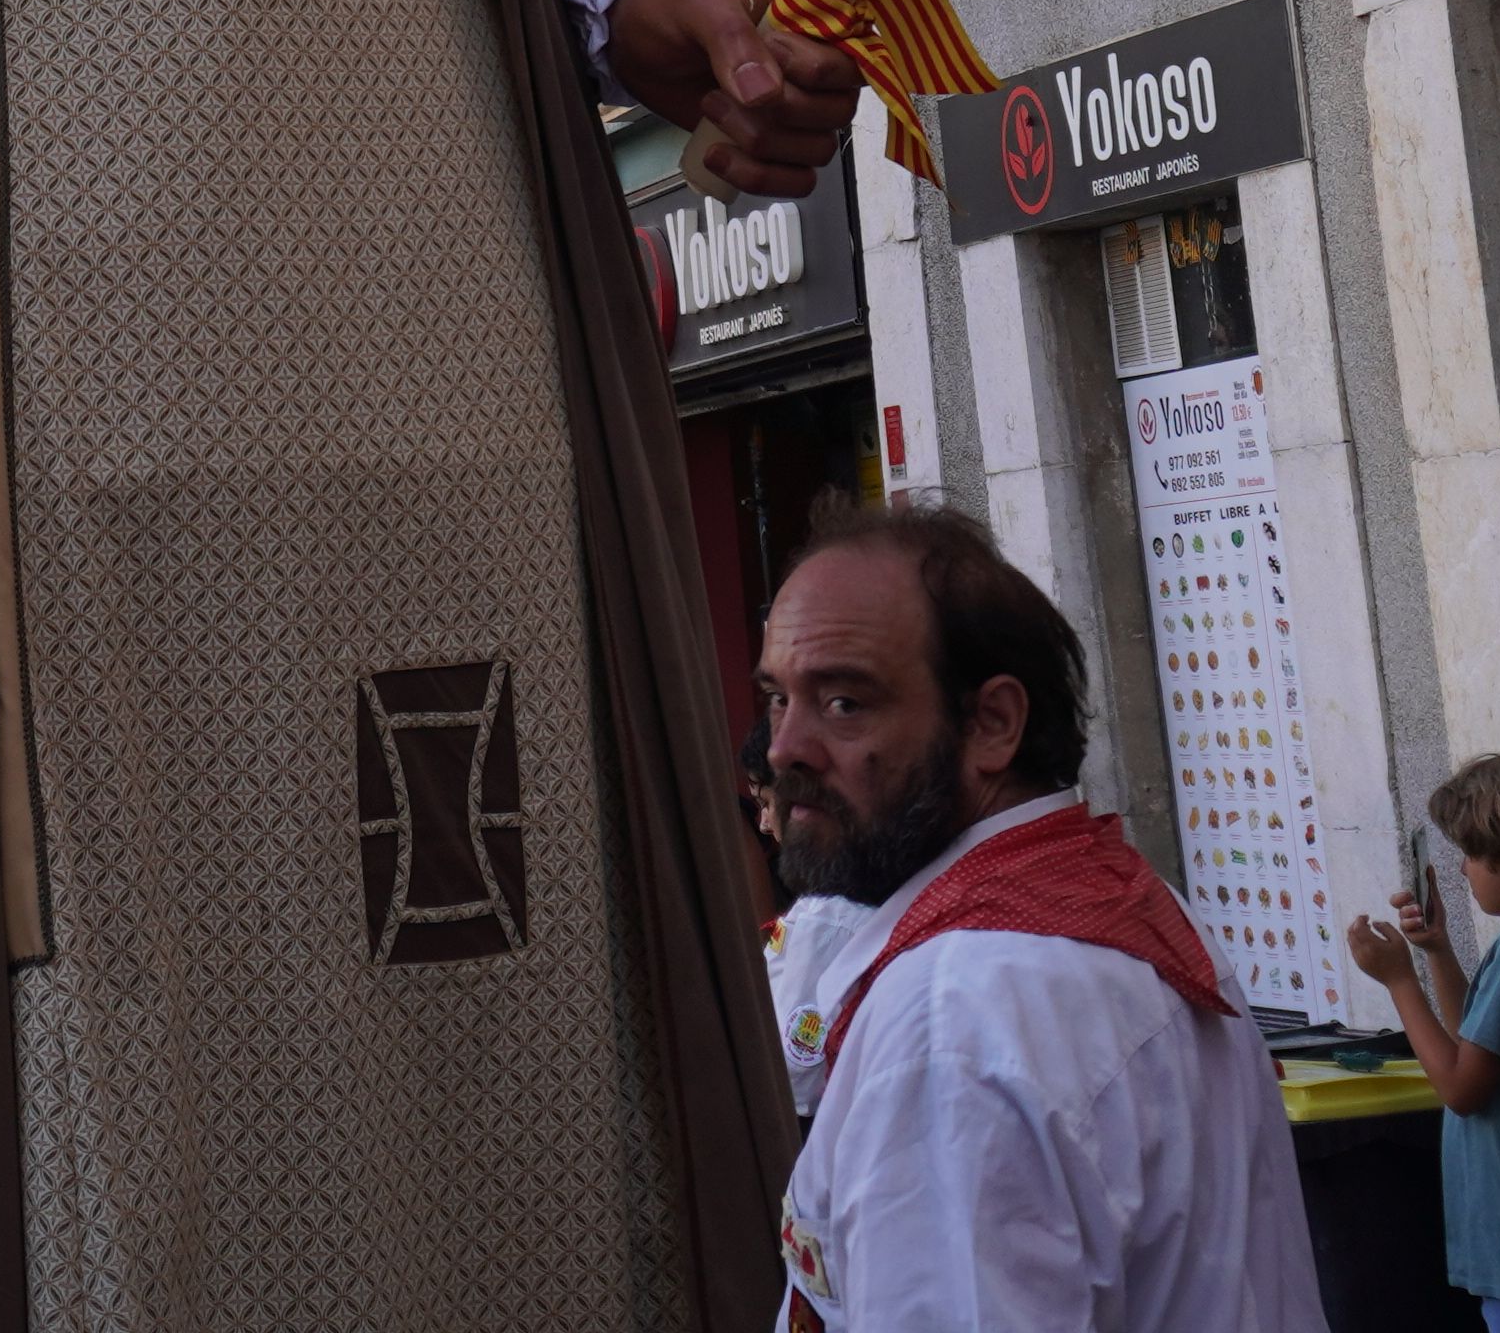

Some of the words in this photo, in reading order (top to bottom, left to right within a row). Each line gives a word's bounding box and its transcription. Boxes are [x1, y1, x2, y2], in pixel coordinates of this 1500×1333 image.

[1055, 52, 1218, 167] Yokoso
[1091, 166, 1151, 197] RESTAURANT
[1155, 151, 1200, 182] JAPONÈS
[665, 195, 801, 315] Yokoso
[699, 317, 744, 346] RESTAURANT
[749, 303, 785, 332] JAPONÈS
[1159, 393, 1225, 439] Yokoso
[1168, 454, 1184, 471] 977
[1187, 452, 1203, 469] 092
[1205, 449, 1222, 466] 561
[1171, 476, 1188, 493] 692
[1189, 473, 1206, 490] 552
[1174, 509, 1212, 525] BUFFET
[1220, 504, 1250, 520] LIBRE
[1258, 503, 1266, 515] A
